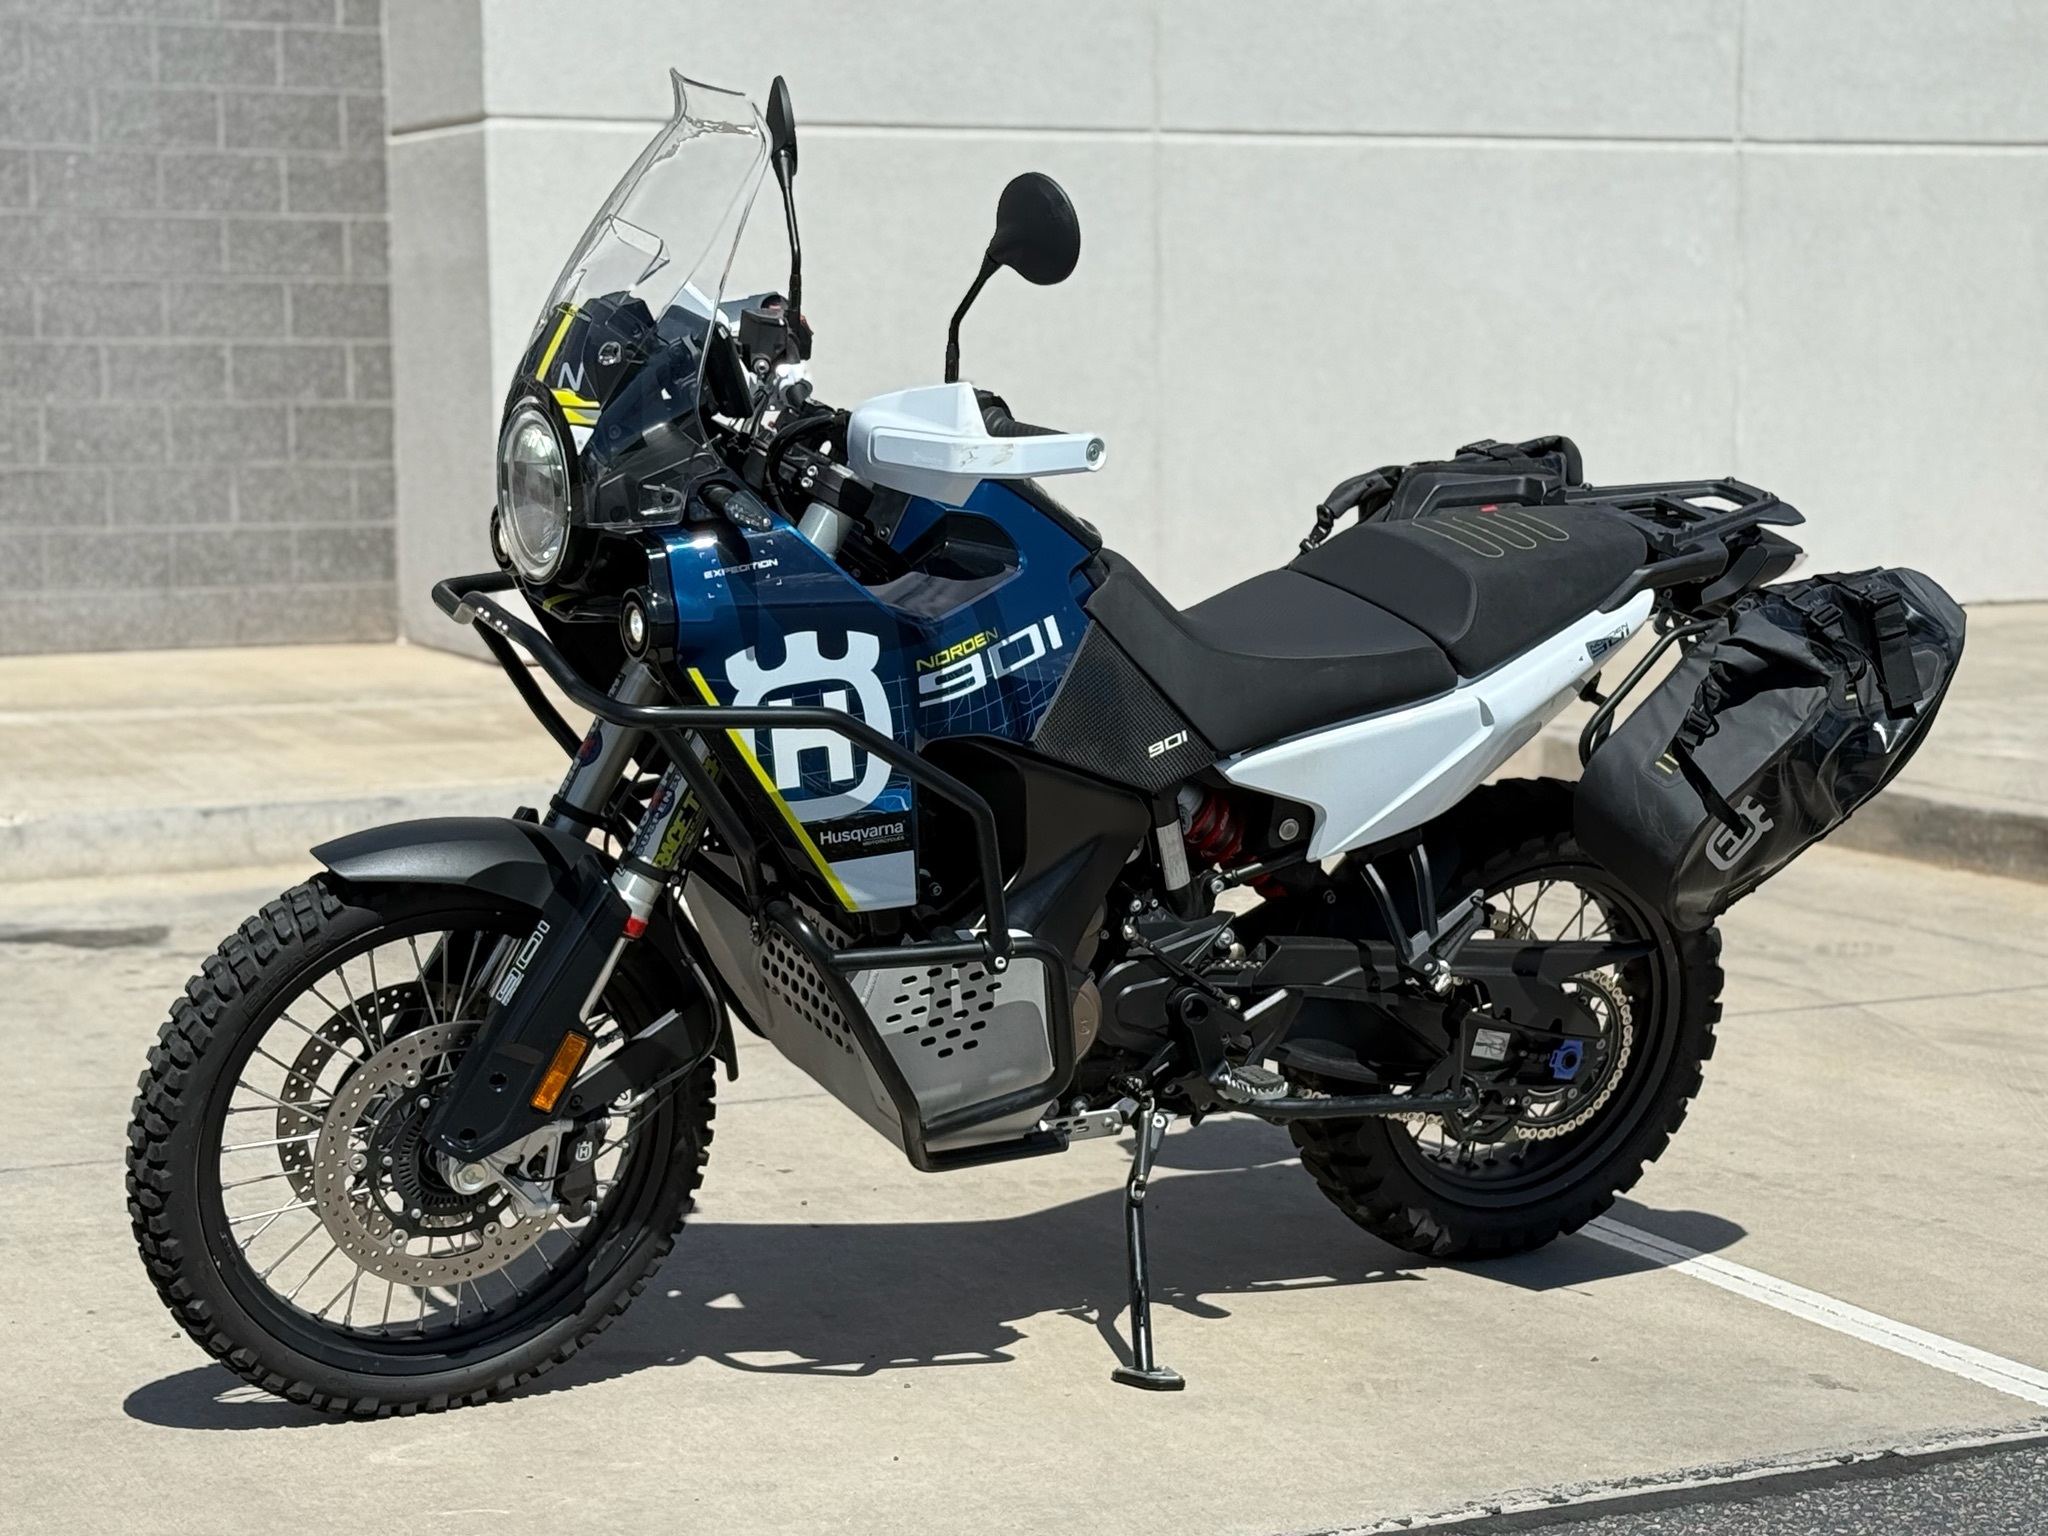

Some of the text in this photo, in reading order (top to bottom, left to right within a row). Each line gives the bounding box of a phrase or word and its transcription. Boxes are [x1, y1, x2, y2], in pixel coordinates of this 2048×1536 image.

[703, 558, 779, 580] EXPEDITION
[915, 627, 1000, 672] NORDEN
[918, 614, 1063, 708] 901
[1148, 730, 1188, 758] 901
[819, 822, 904, 846] Husqvarna
